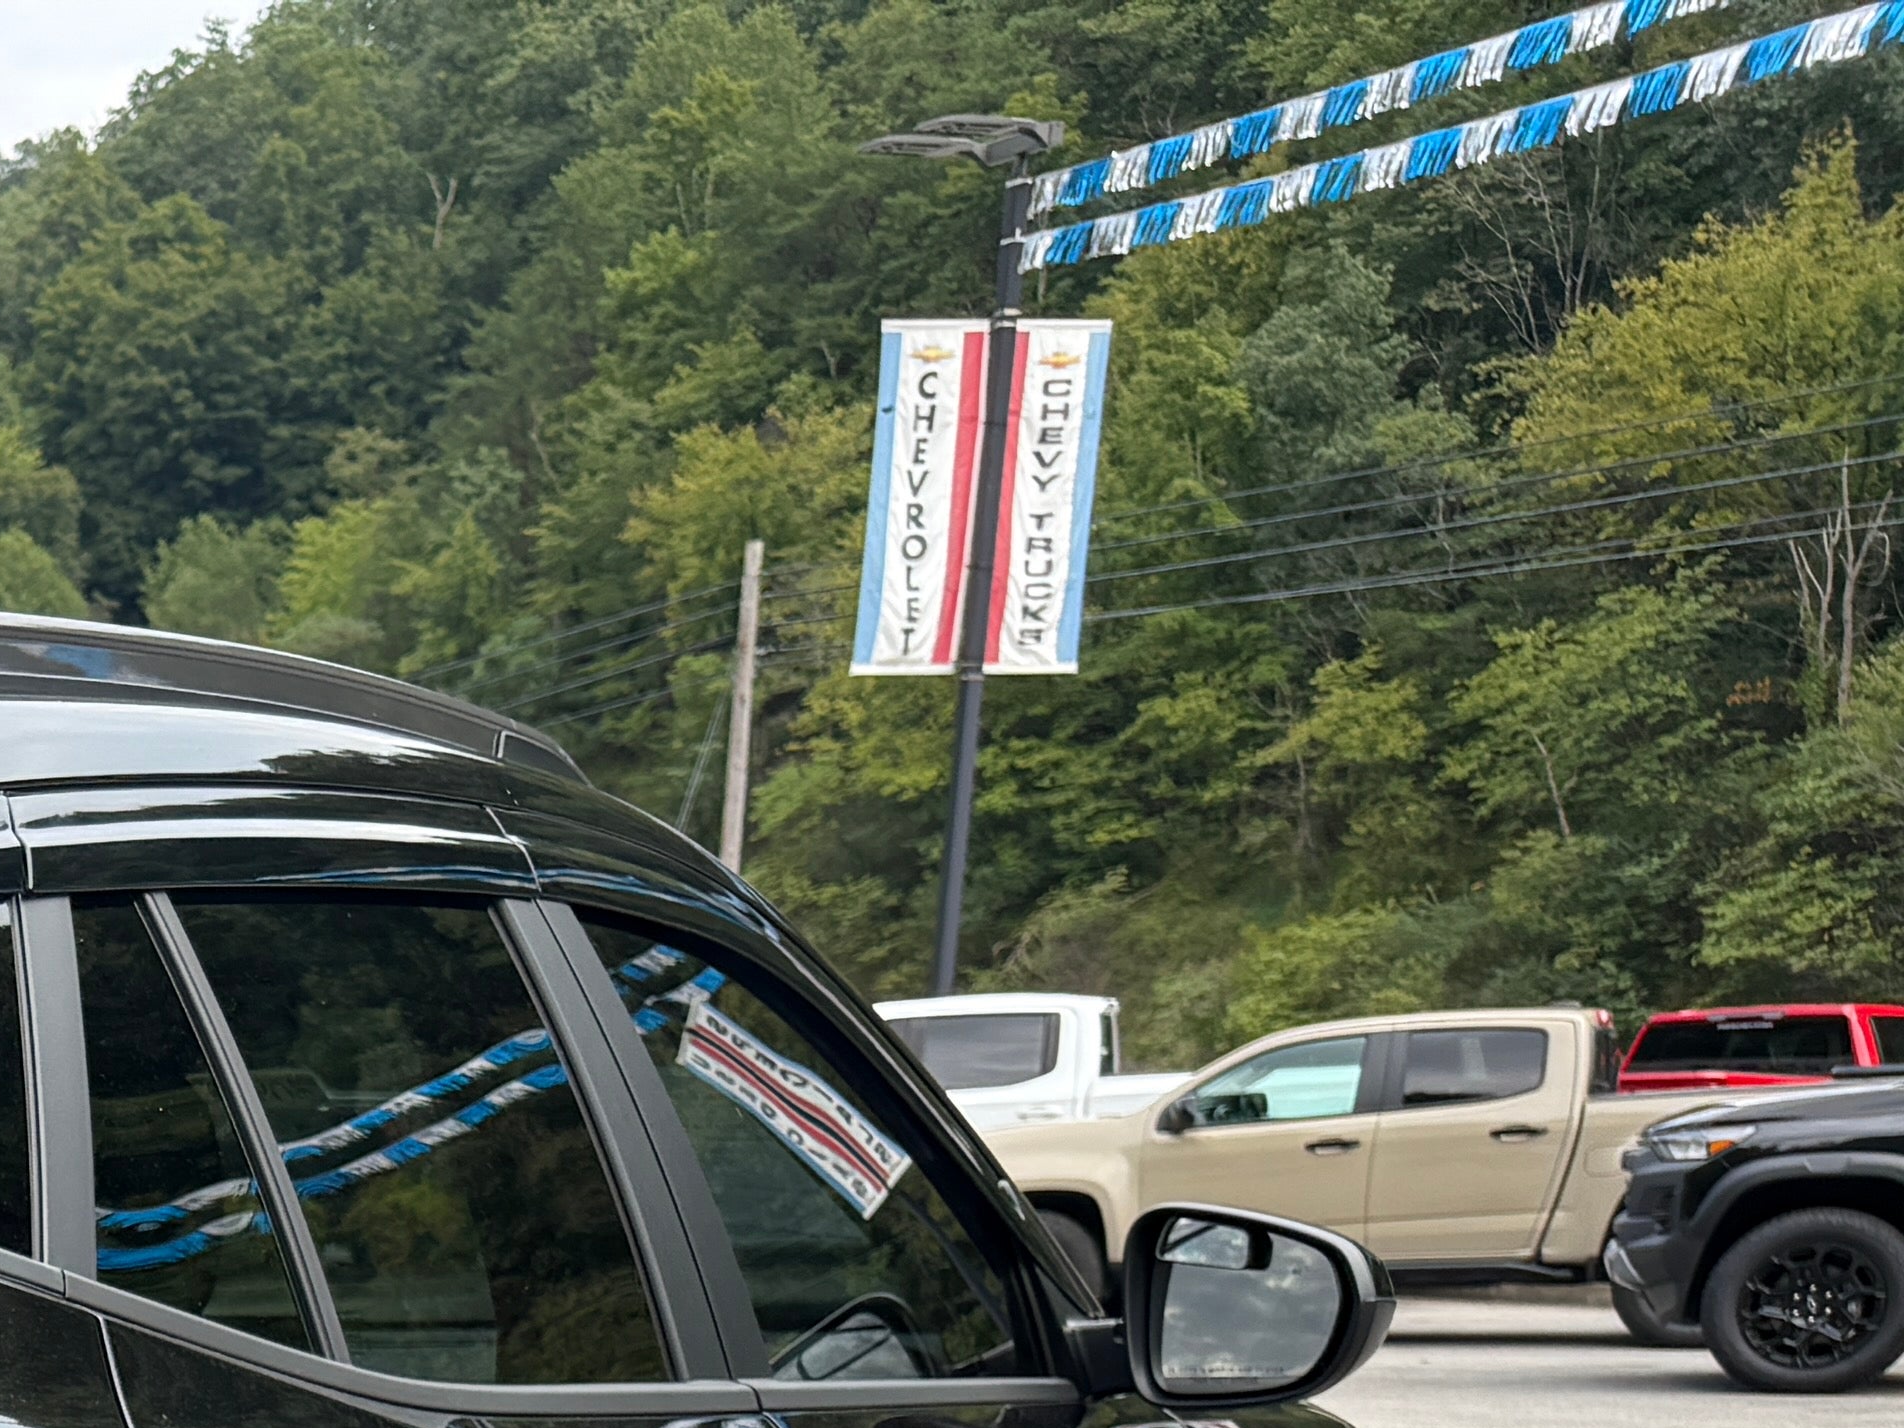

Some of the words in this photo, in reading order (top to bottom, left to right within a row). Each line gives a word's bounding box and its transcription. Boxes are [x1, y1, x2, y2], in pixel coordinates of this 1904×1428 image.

[1031, 378, 1073, 493] CHEVY
[900, 371, 938, 657] CHEVROLET
[1017, 512, 1054, 647] TRUCKS
